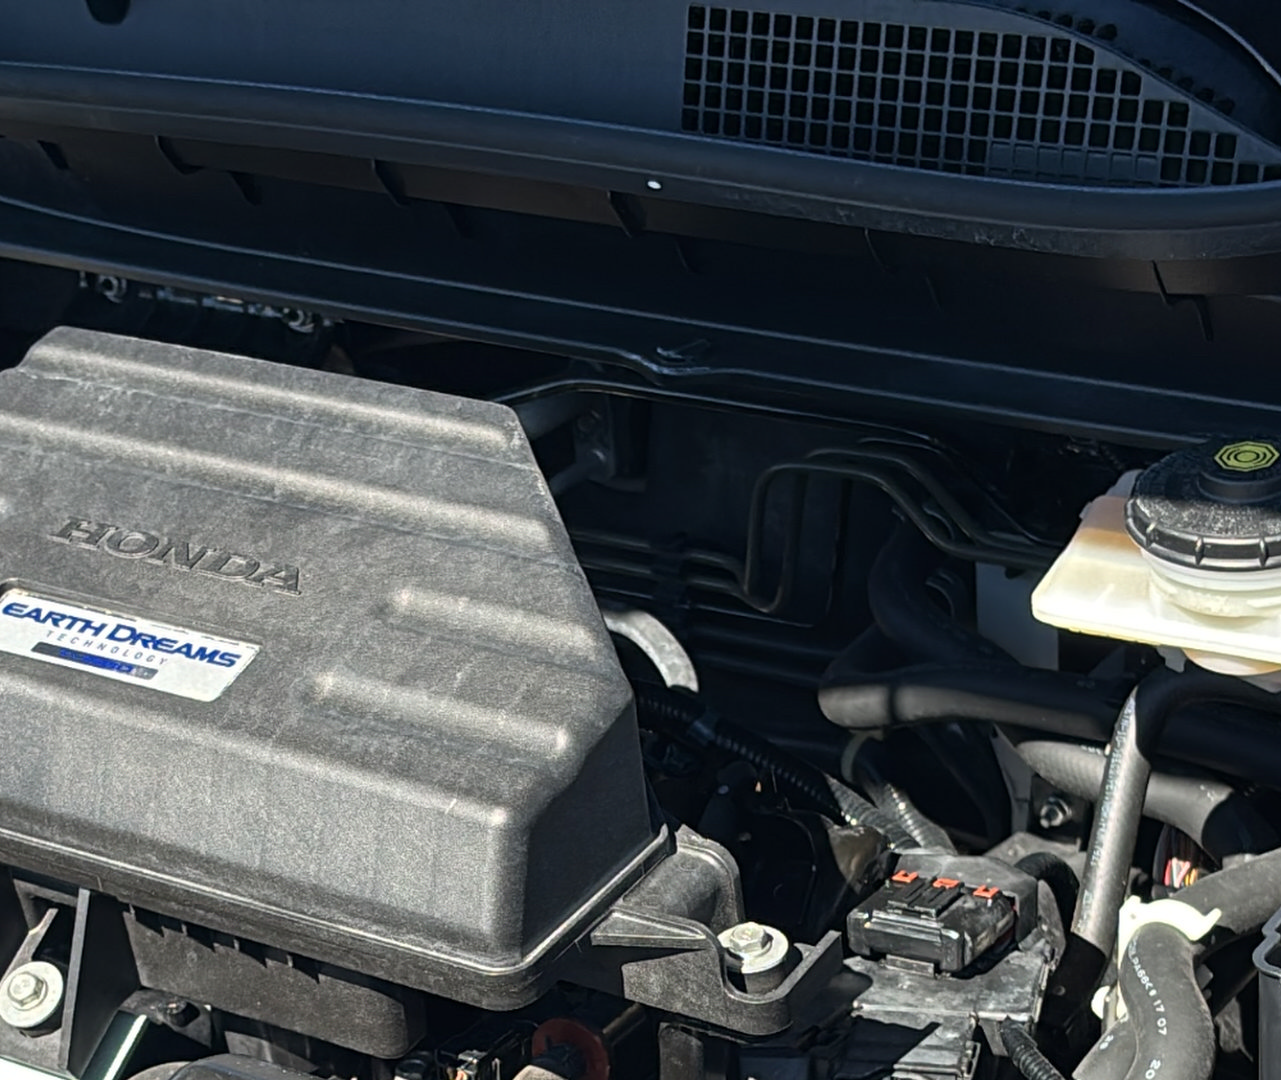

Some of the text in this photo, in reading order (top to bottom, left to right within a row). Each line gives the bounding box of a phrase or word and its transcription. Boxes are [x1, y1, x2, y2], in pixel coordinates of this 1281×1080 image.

[47, 515, 302, 596] HONDA
[2, 602, 108, 637] EARTH
[106, 623, 243, 668] DREAMS
[45, 630, 169, 665] TECHNOLOGY
[1153, 999, 1165, 1013] 17
[1157, 1017, 1168, 1036] 07
[1145, 1058, 1161, 1080] 20
